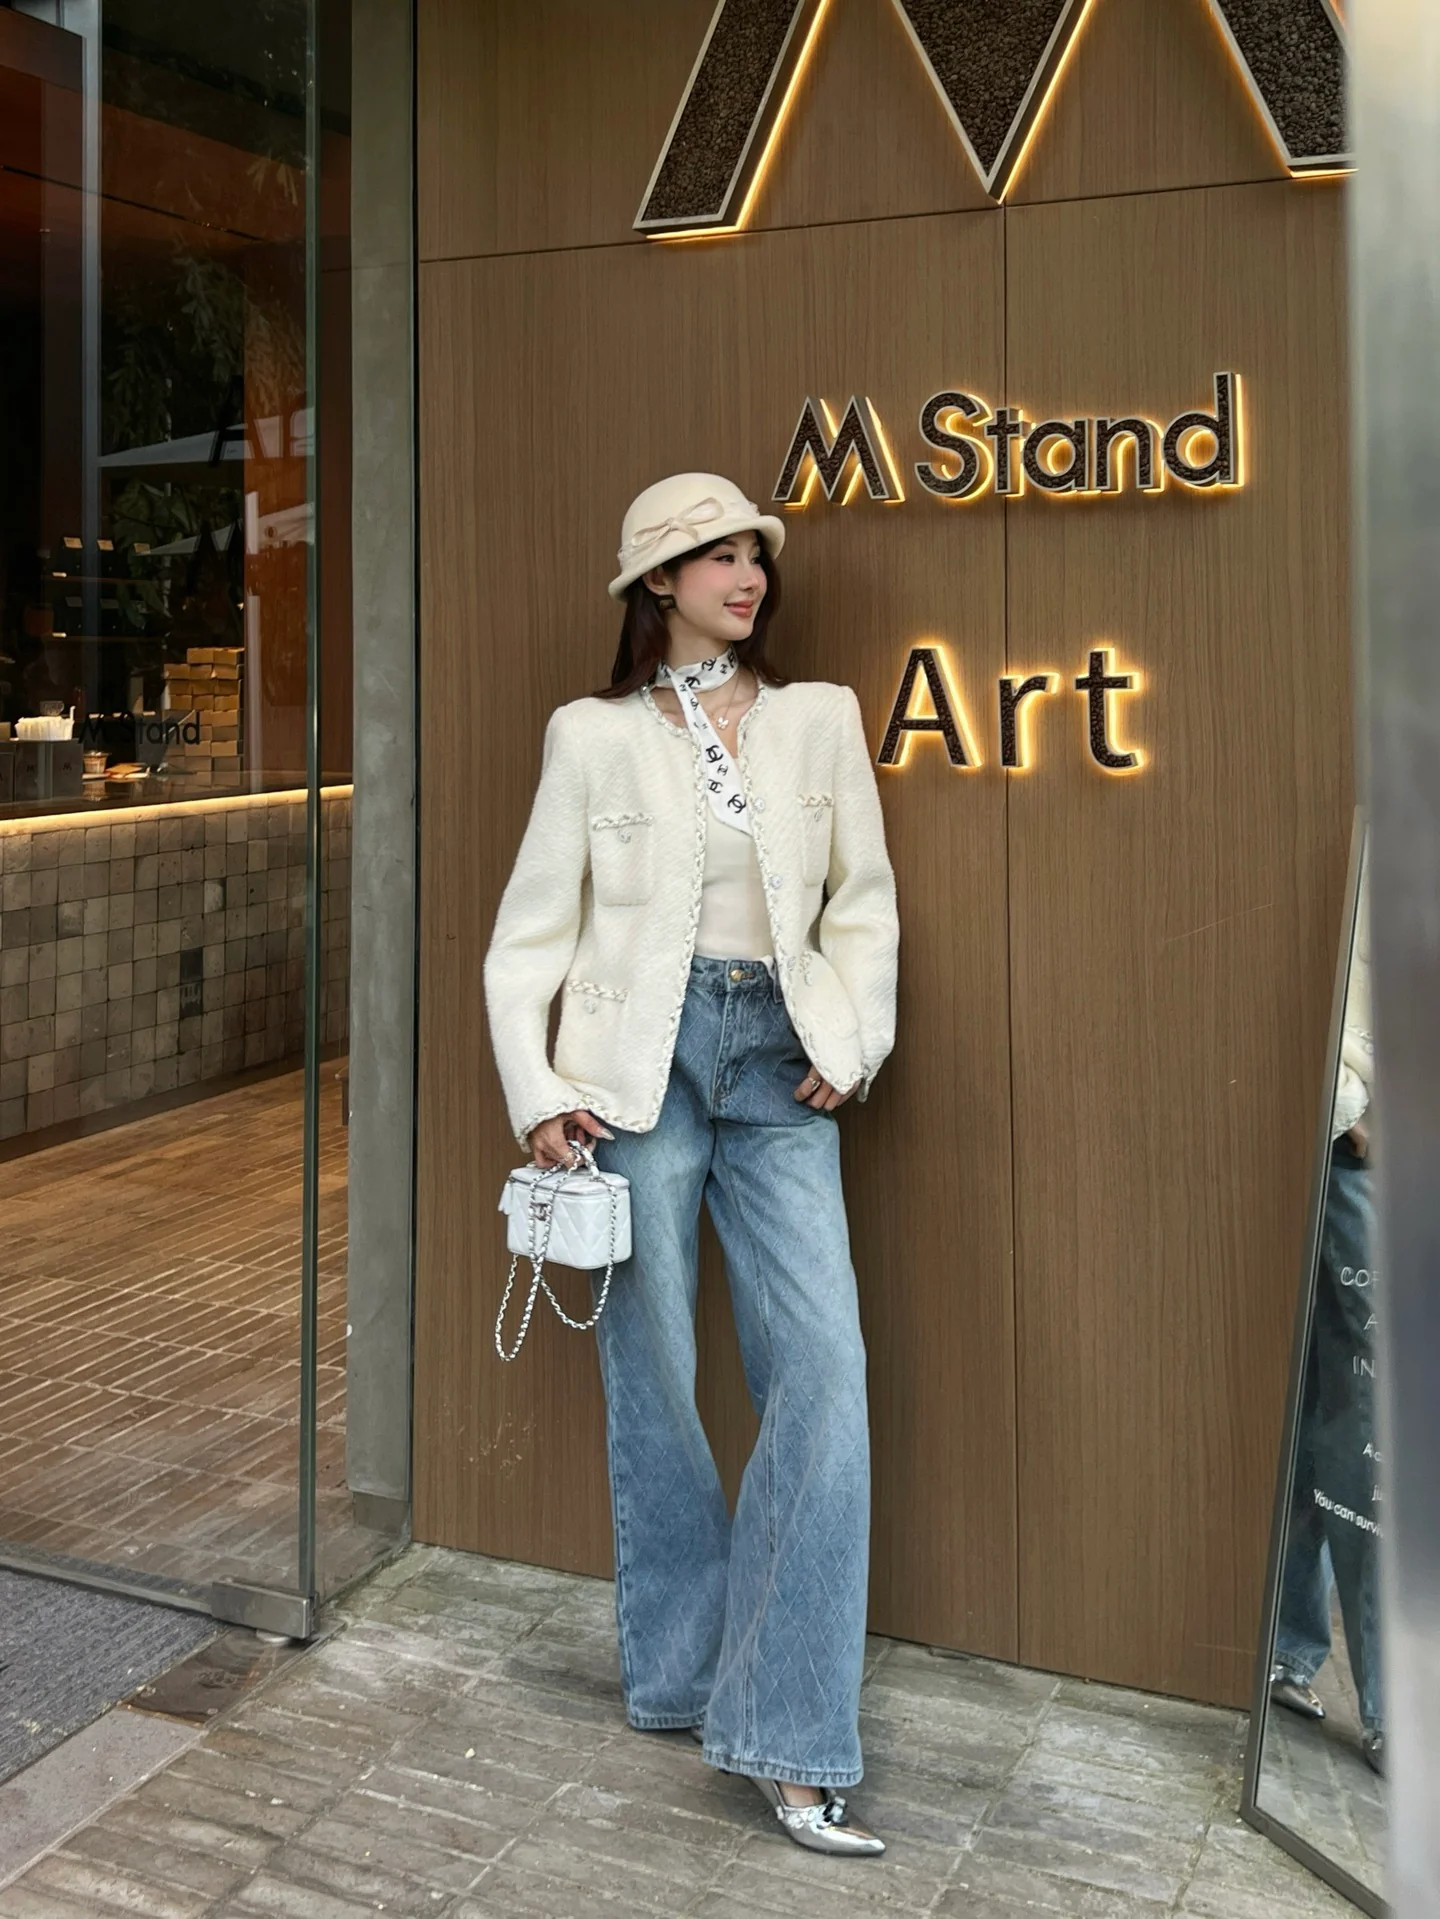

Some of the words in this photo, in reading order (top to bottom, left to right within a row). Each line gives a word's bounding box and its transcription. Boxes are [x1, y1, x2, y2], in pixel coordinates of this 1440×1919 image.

[771, 395, 904, 505] M
[914, 370, 1244, 502] Stand
[876, 643, 1145, 774] Art
[1313, 1488, 1333, 1511] You
[1333, 1503, 1355, 1523] can
